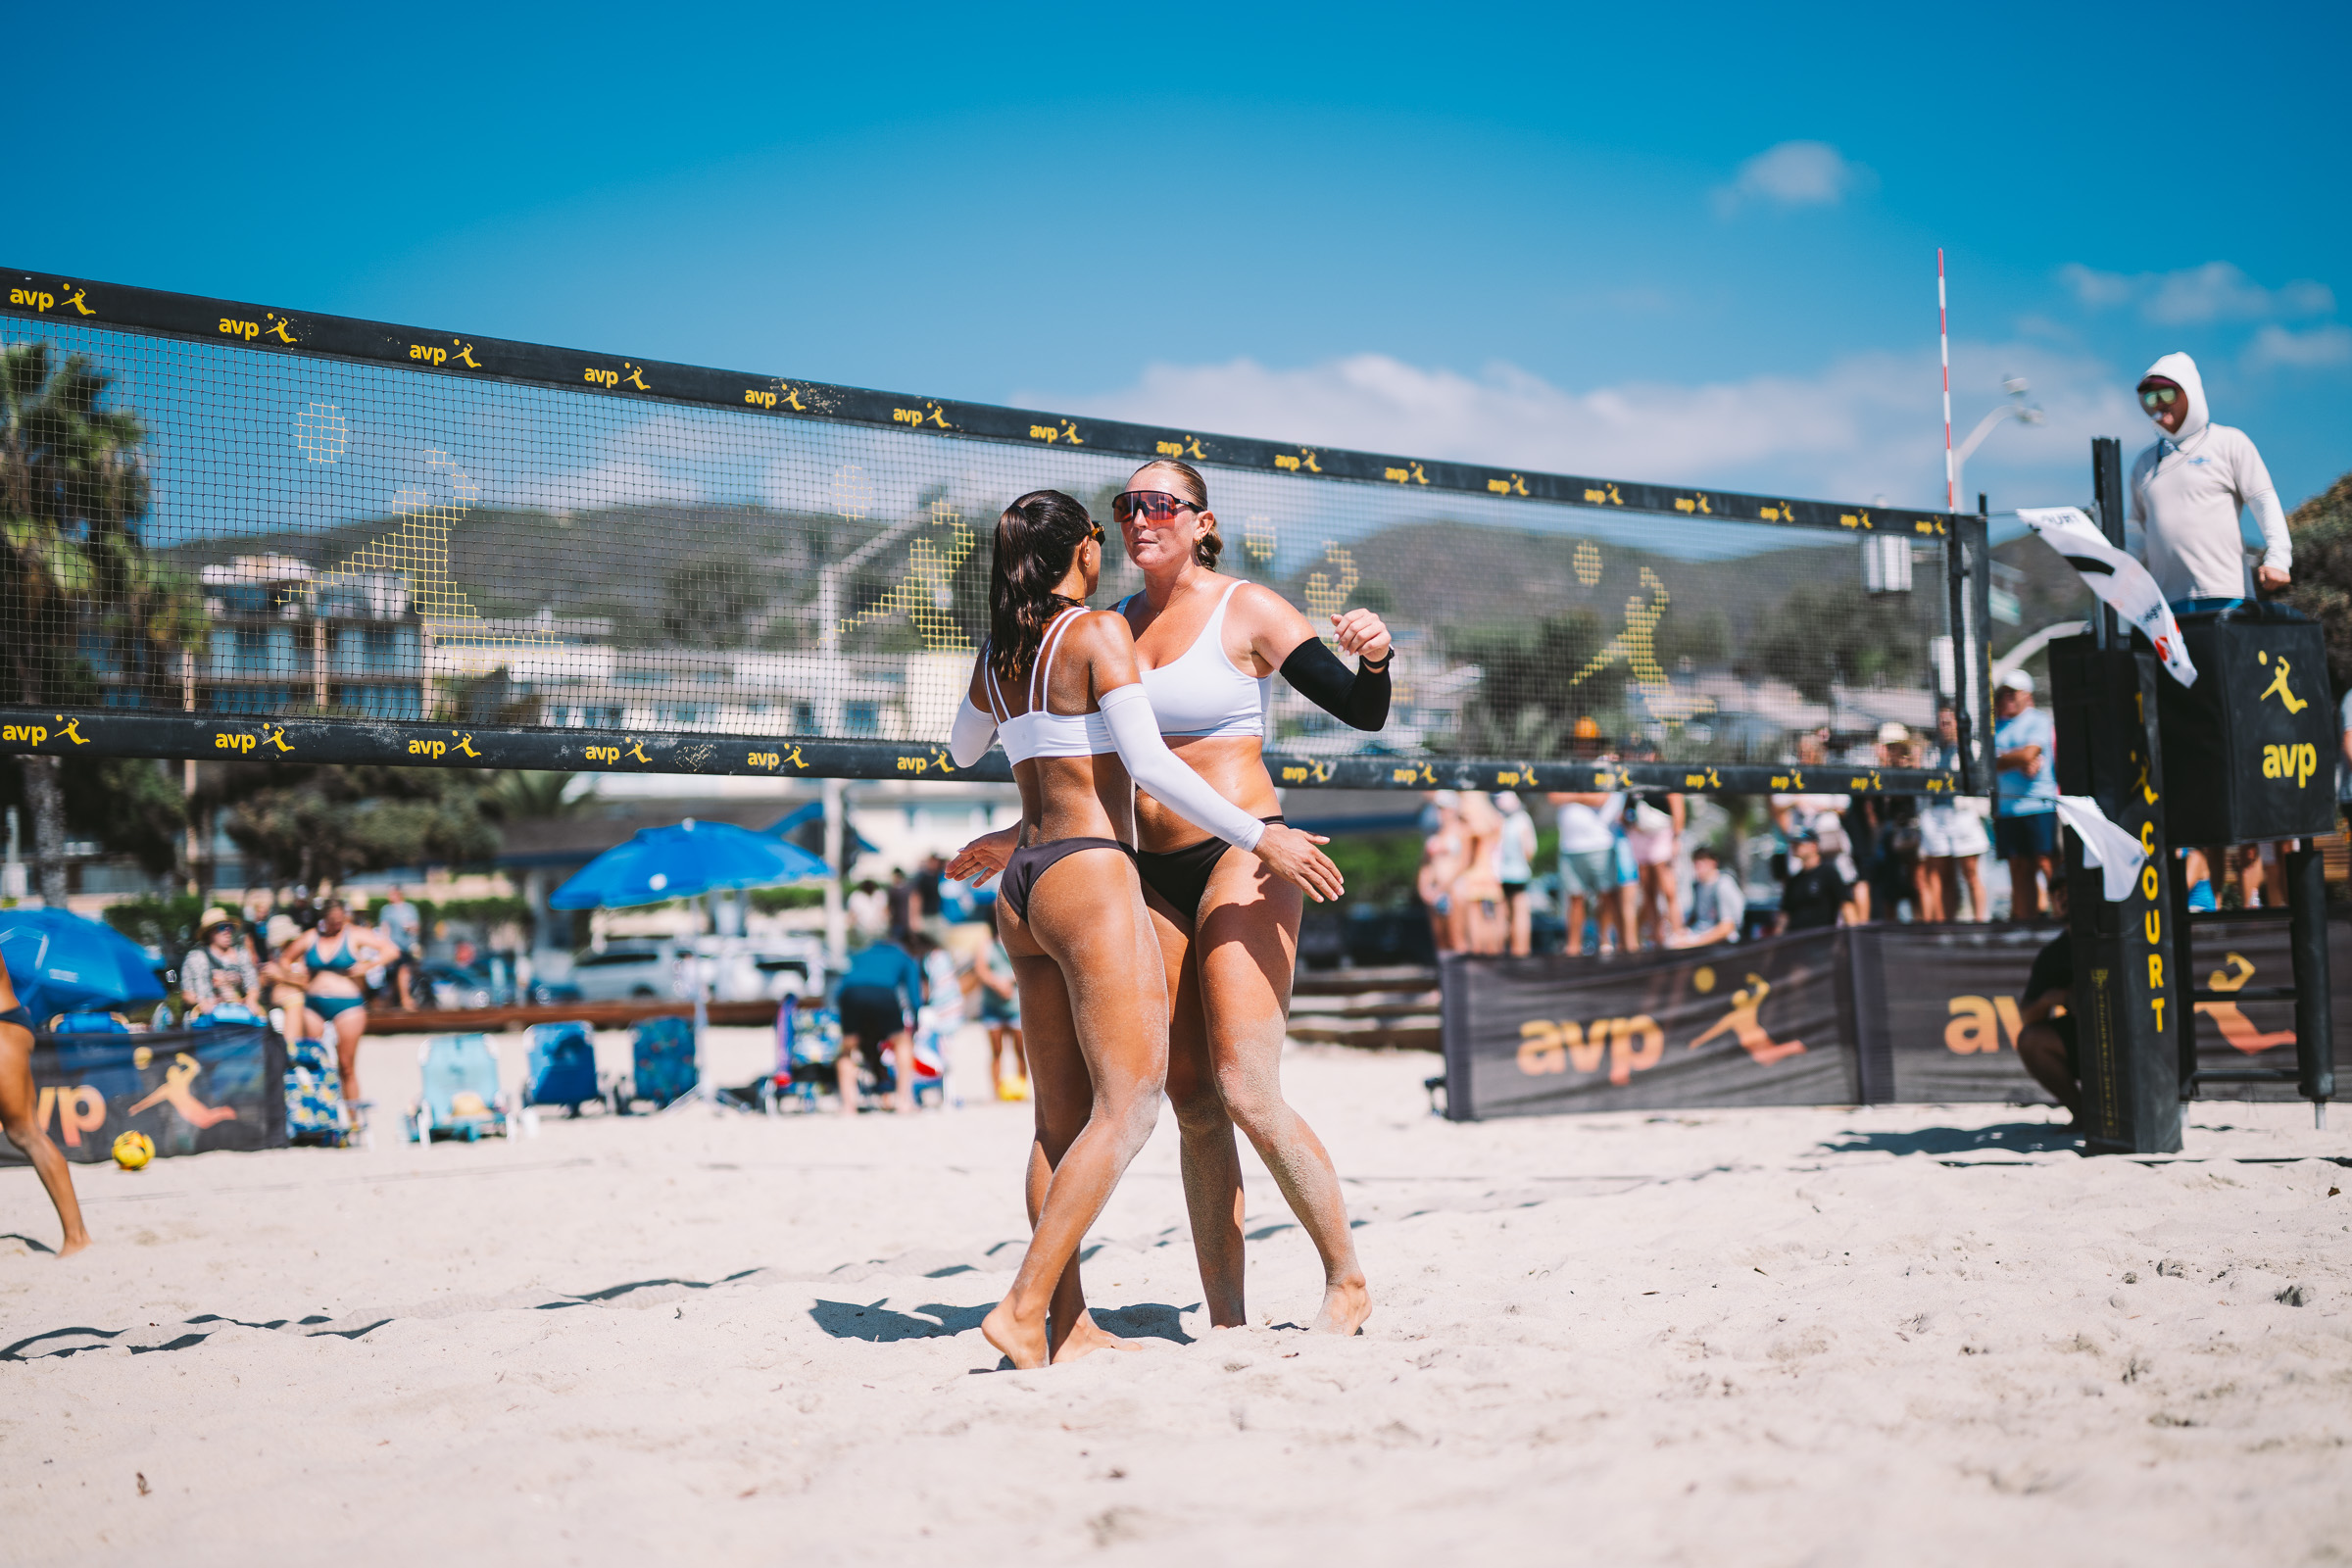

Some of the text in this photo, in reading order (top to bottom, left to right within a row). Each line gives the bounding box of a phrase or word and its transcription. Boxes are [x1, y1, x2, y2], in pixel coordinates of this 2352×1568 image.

[10, 289, 54, 312] avp
[219, 318, 259, 341] avp
[410, 345, 446, 366] avp
[584, 368, 618, 388] avp
[745, 389, 776, 409] avp
[894, 408, 922, 427] avp
[1030, 424, 1057, 443] avp
[1156, 440, 1183, 458] avp
[1274, 454, 1299, 471] avp
[1385, 467, 1408, 483] avp
[1488, 479, 1510, 495] avp
[1585, 489, 1605, 505] avp
[1675, 498, 1694, 514] avp
[1760, 507, 1779, 522] avp
[1839, 514, 1858, 530] avp
[1915, 520, 1933, 536] avp
[2, 725, 47, 746] avp
[216, 733, 256, 754] avp
[409, 740, 446, 759] avp
[585, 746, 619, 764] avp
[748, 752, 779, 770] avp
[897, 757, 927, 774] avp
[2263, 742, 2317, 788] avp
[1282, 766, 1307, 783] avp
[1394, 767, 1416, 784] avp
[1496, 771, 1519, 787] avp
[1593, 772, 1613, 788] avp
[1685, 774, 1705, 790] avp
[1770, 775, 1789, 791] avp
[1850, 777, 1869, 793] avp
[1926, 779, 1943, 795] avp
[2140, 821, 2165, 1033] COURT
[1517, 1014, 1664, 1085] avp
